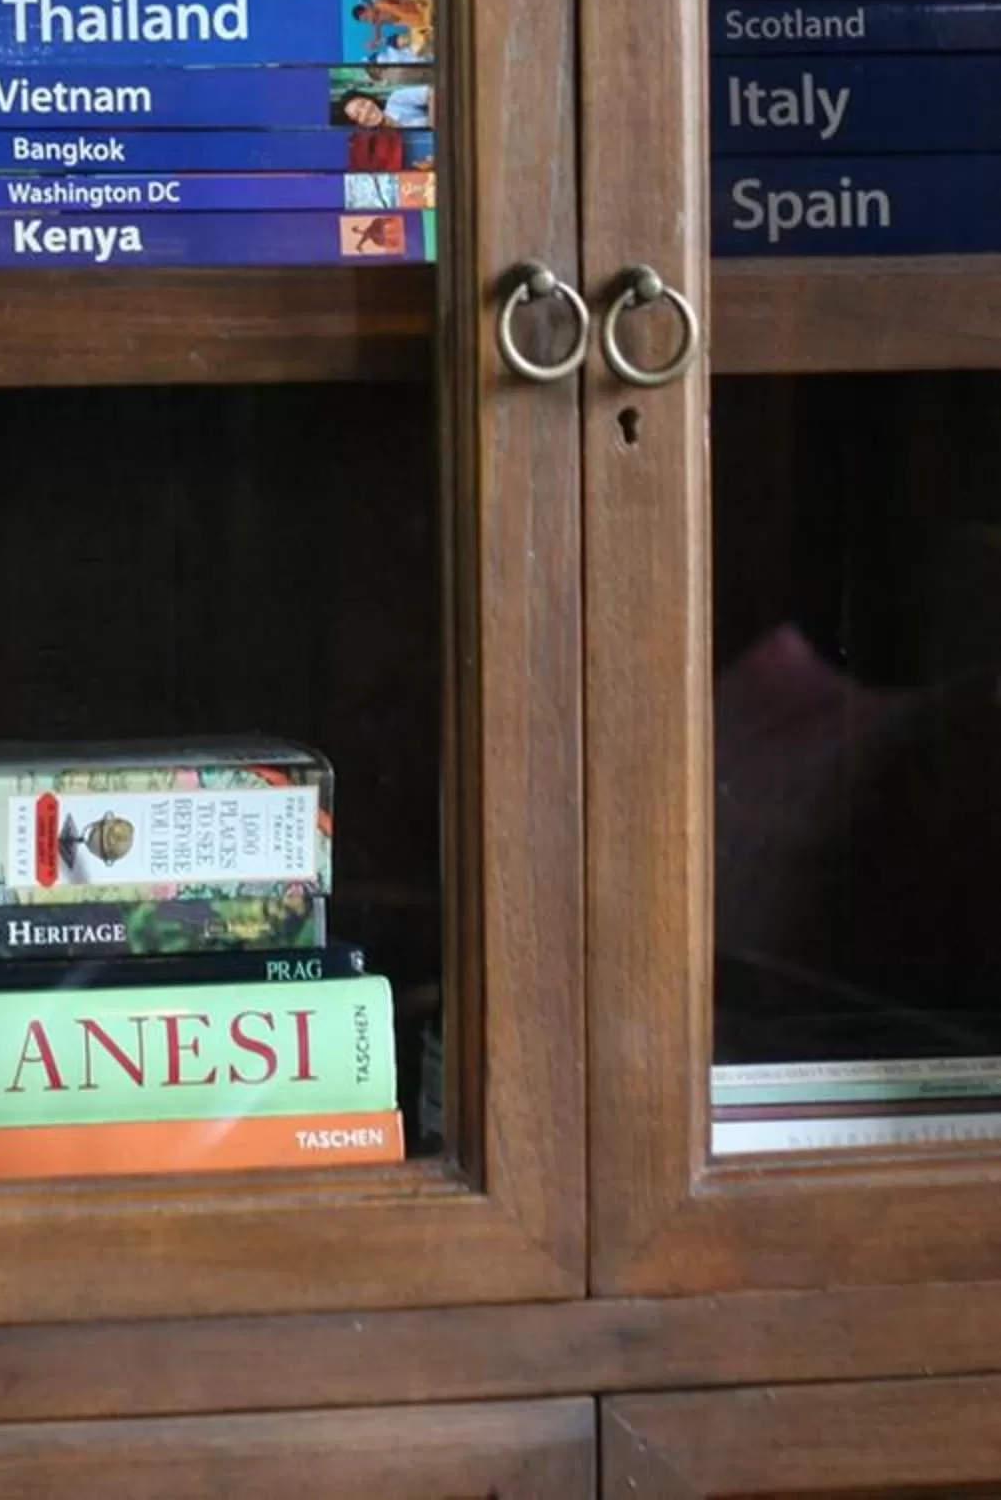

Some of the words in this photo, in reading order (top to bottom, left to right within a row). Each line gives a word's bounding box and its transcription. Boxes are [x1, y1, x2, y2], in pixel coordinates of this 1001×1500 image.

[726, 8, 865, 40] Scotland
[729, 72, 850, 140] Italy
[13, 137, 125, 166] Bangkok
[8, 182, 145, 208] Washington
[148, 181, 181, 202] DC
[731, 176, 890, 243] Spain
[13, 219, 143, 263] Kenya
[150, 799, 170, 835] YOU
[196, 802, 216, 829] TO
[173, 798, 193, 874] BEFORE
[196, 830, 216, 867] SEE
[219, 800, 239, 870] PLACES
[150, 841, 170, 875] DIE
[8, 920, 127, 946] HERITAGE
[265, 958, 322, 981] PRAG
[354, 1004, 371, 1086] TASCHEN
[295, 1128, 384, 1150] TASCHEN
